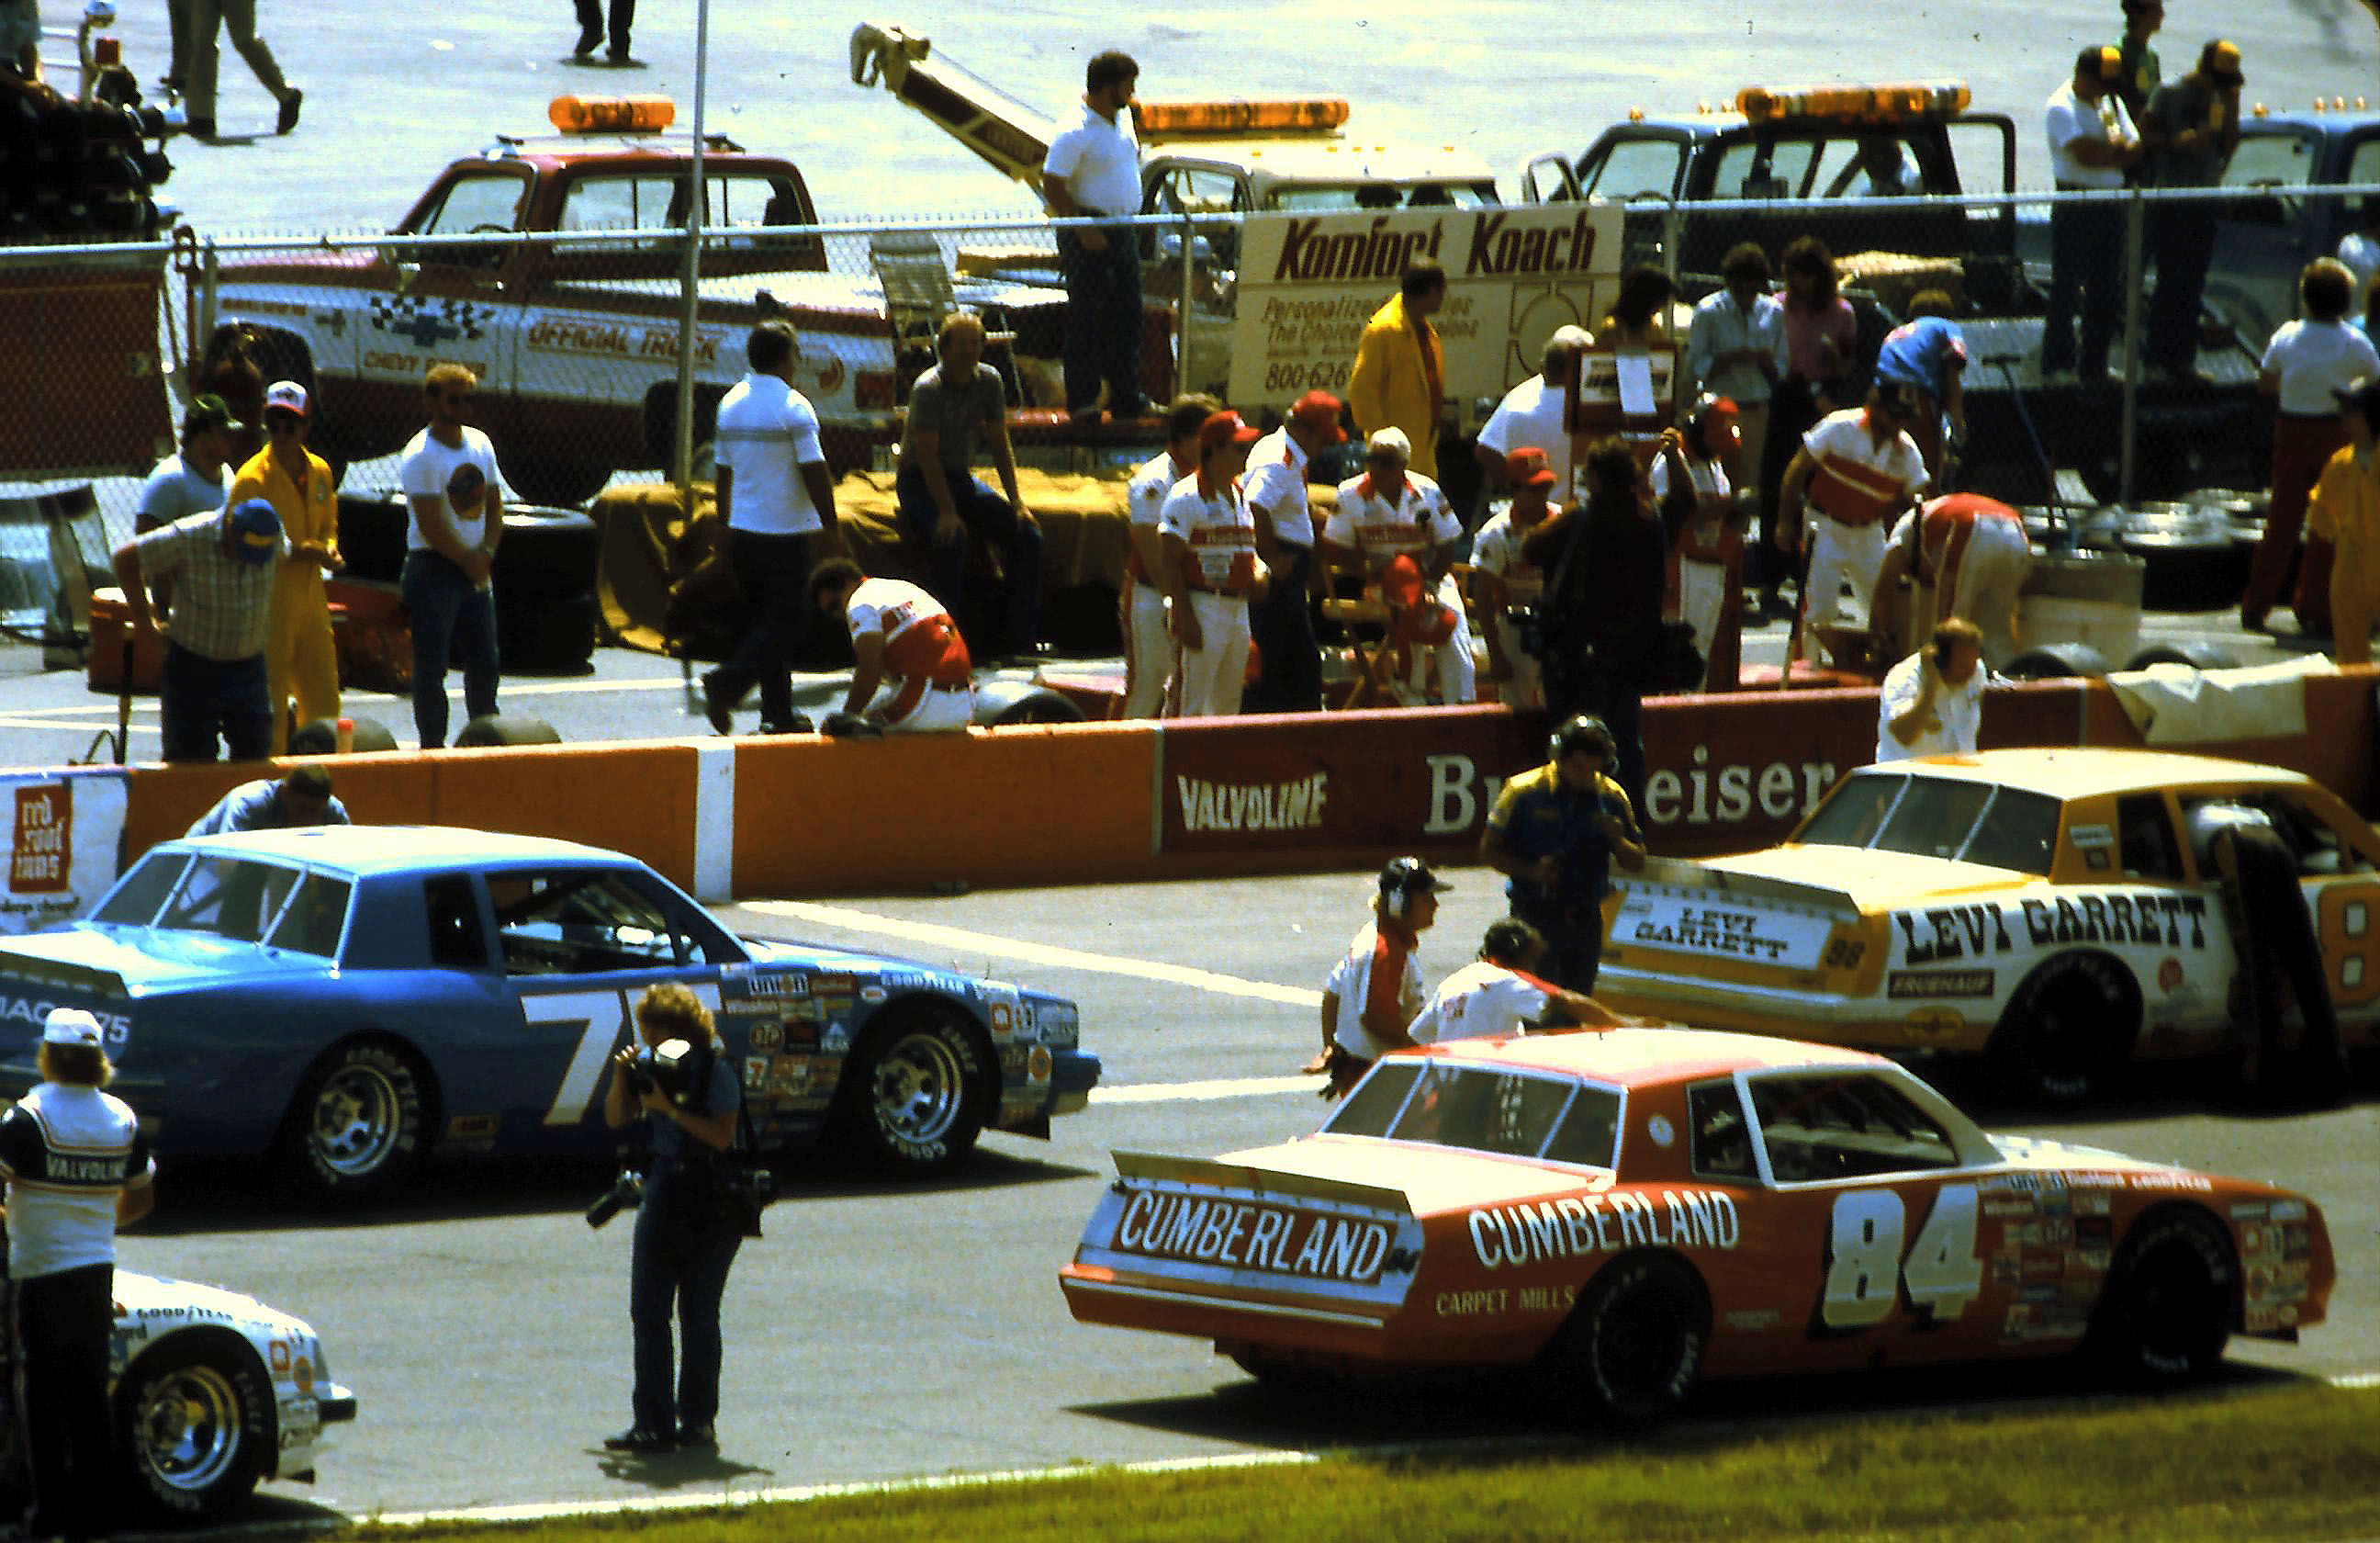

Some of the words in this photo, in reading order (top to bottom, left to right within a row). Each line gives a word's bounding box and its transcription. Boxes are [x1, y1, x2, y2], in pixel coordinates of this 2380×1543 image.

[1274, 216, 1445, 281] Komfort
[1466, 208, 1597, 275] Koach
[1262, 295, 1389, 323] Personalize
[528, 321, 629, 354] OFFICIAL
[643, 329, 716, 361] TRUK
[1177, 772, 1328, 831] VALVOLINE
[1423, 745, 1836, 833] Beiser
[1634, 920, 1789, 959] GARRETT
[1678, 906, 1757, 935] LEVI
[1894, 901, 2014, 965] LEVI
[2019, 894, 2206, 950] GARRETT
[45, 1149, 127, 1177] VALVOLIN
[1119, 1188, 1389, 1281] CUMBERLAND
[1468, 1190, 1740, 1269] CUMBERLAND
[1821, 1184, 1983, 1327] 84
[1435, 1289, 1509, 1317] CARPET
[1519, 1284, 1576, 1311] MILLS
